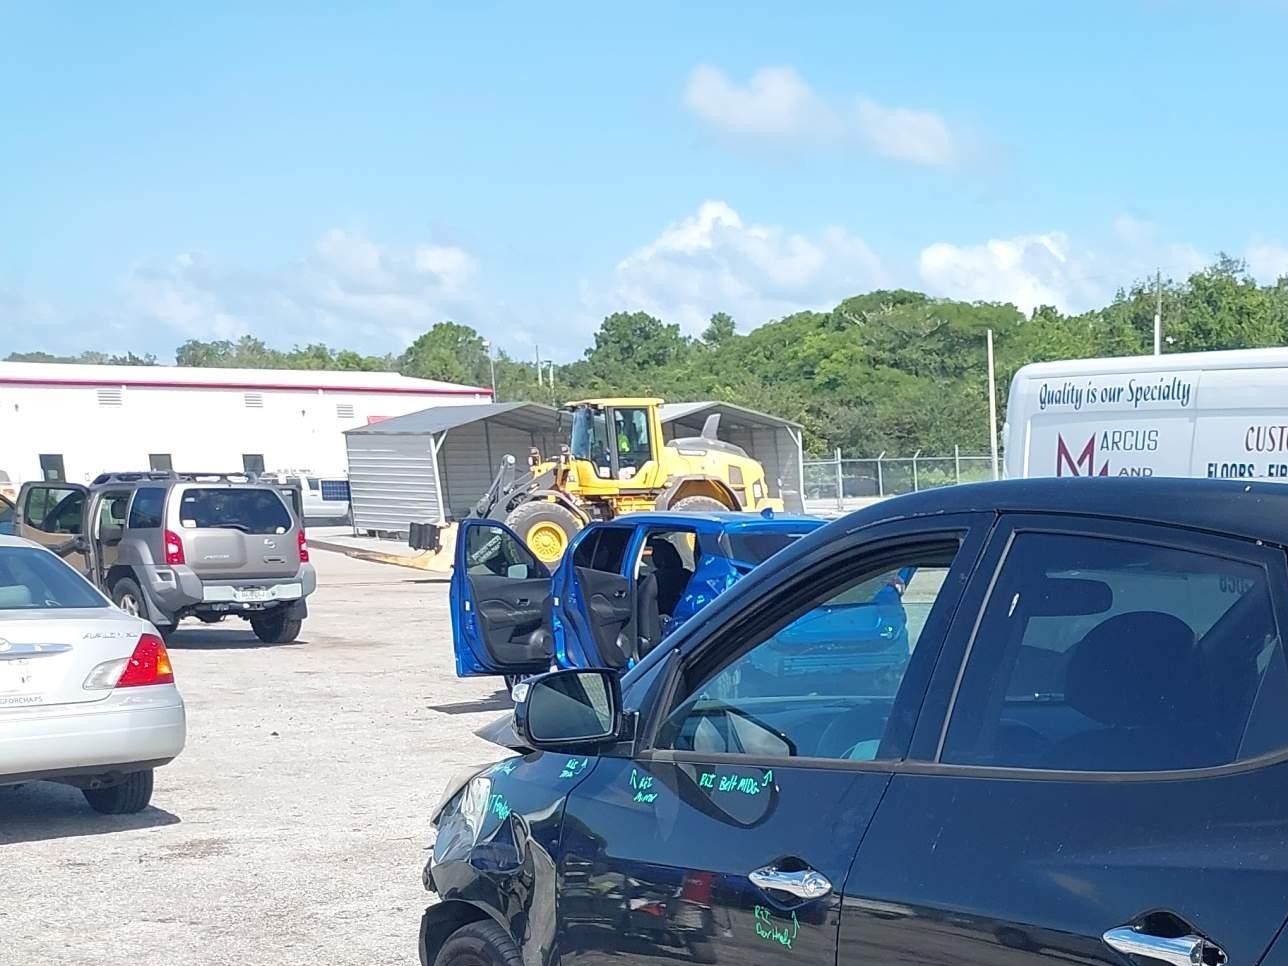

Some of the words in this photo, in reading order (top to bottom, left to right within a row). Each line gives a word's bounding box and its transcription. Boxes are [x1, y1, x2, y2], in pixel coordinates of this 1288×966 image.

[1039, 381, 1083, 410] Quality
[1086, 380, 1097, 405] is
[1099, 386, 1125, 404] our
[1126, 377, 1192, 408] Specialty
